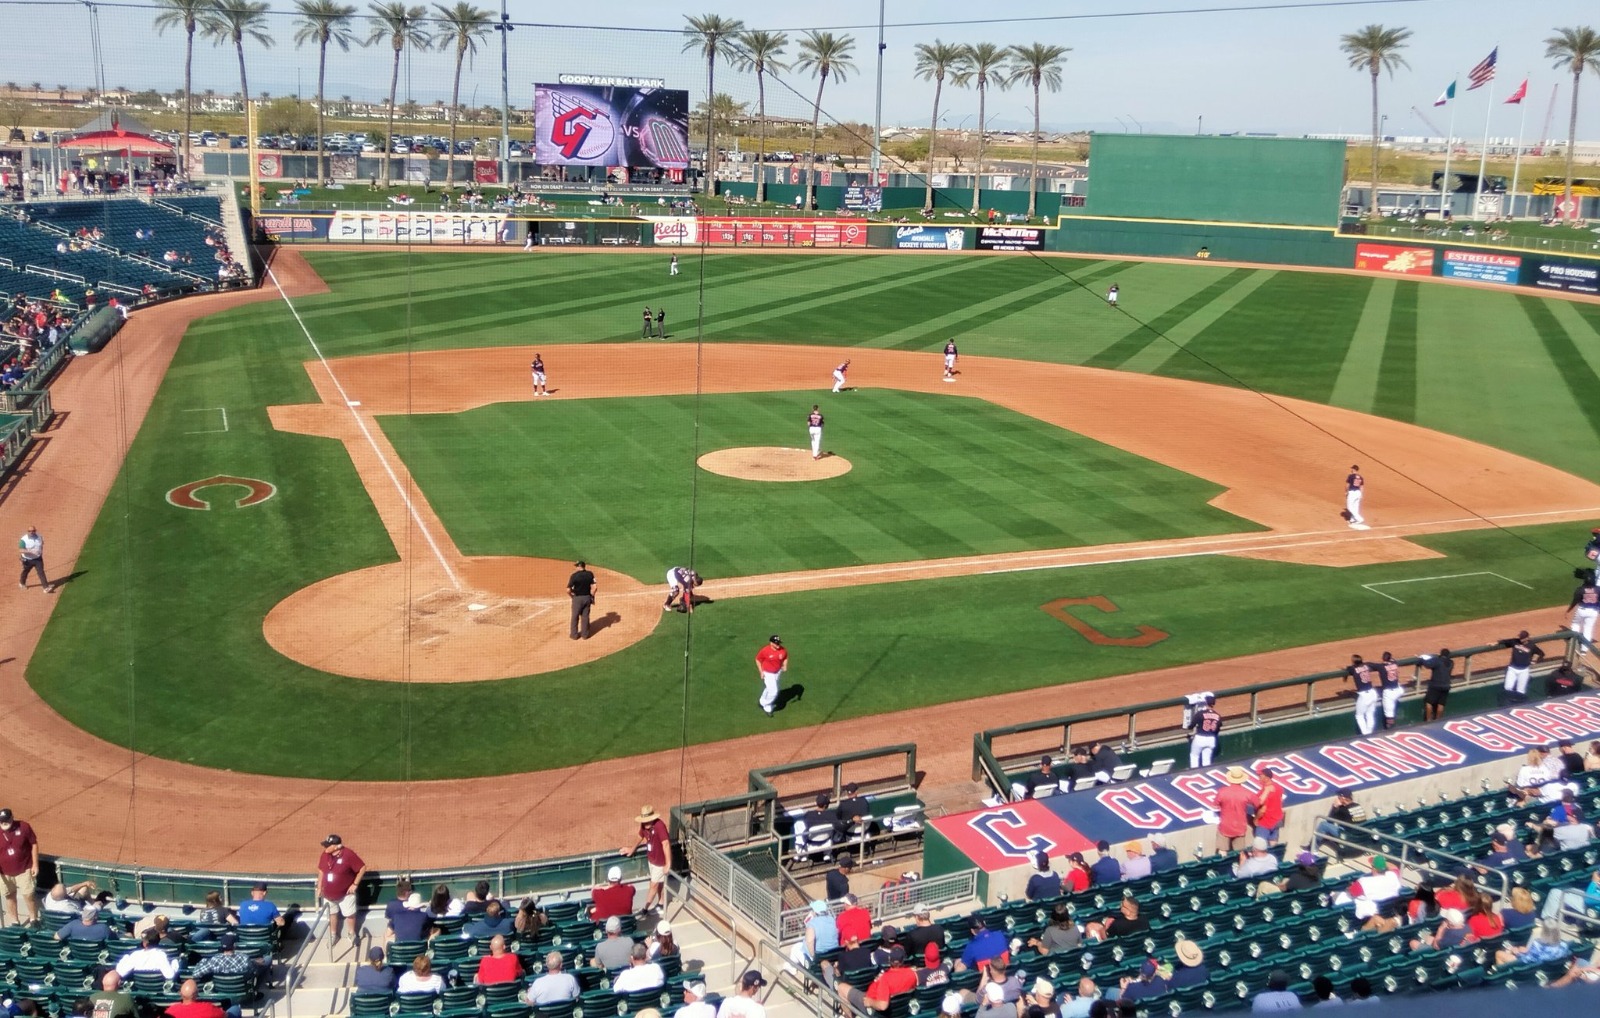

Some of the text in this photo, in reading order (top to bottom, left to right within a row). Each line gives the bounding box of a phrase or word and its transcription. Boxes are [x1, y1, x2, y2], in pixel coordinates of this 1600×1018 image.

[559, 74, 664, 88] GOODYEAR BALLPARK
[622, 124, 640, 138] VS
[653, 221, 689, 240] Reds
[896, 225, 924, 239] Culver's
[1550, 266, 1564, 275] PRO
[1564, 268, 1597, 279] HOUSING
